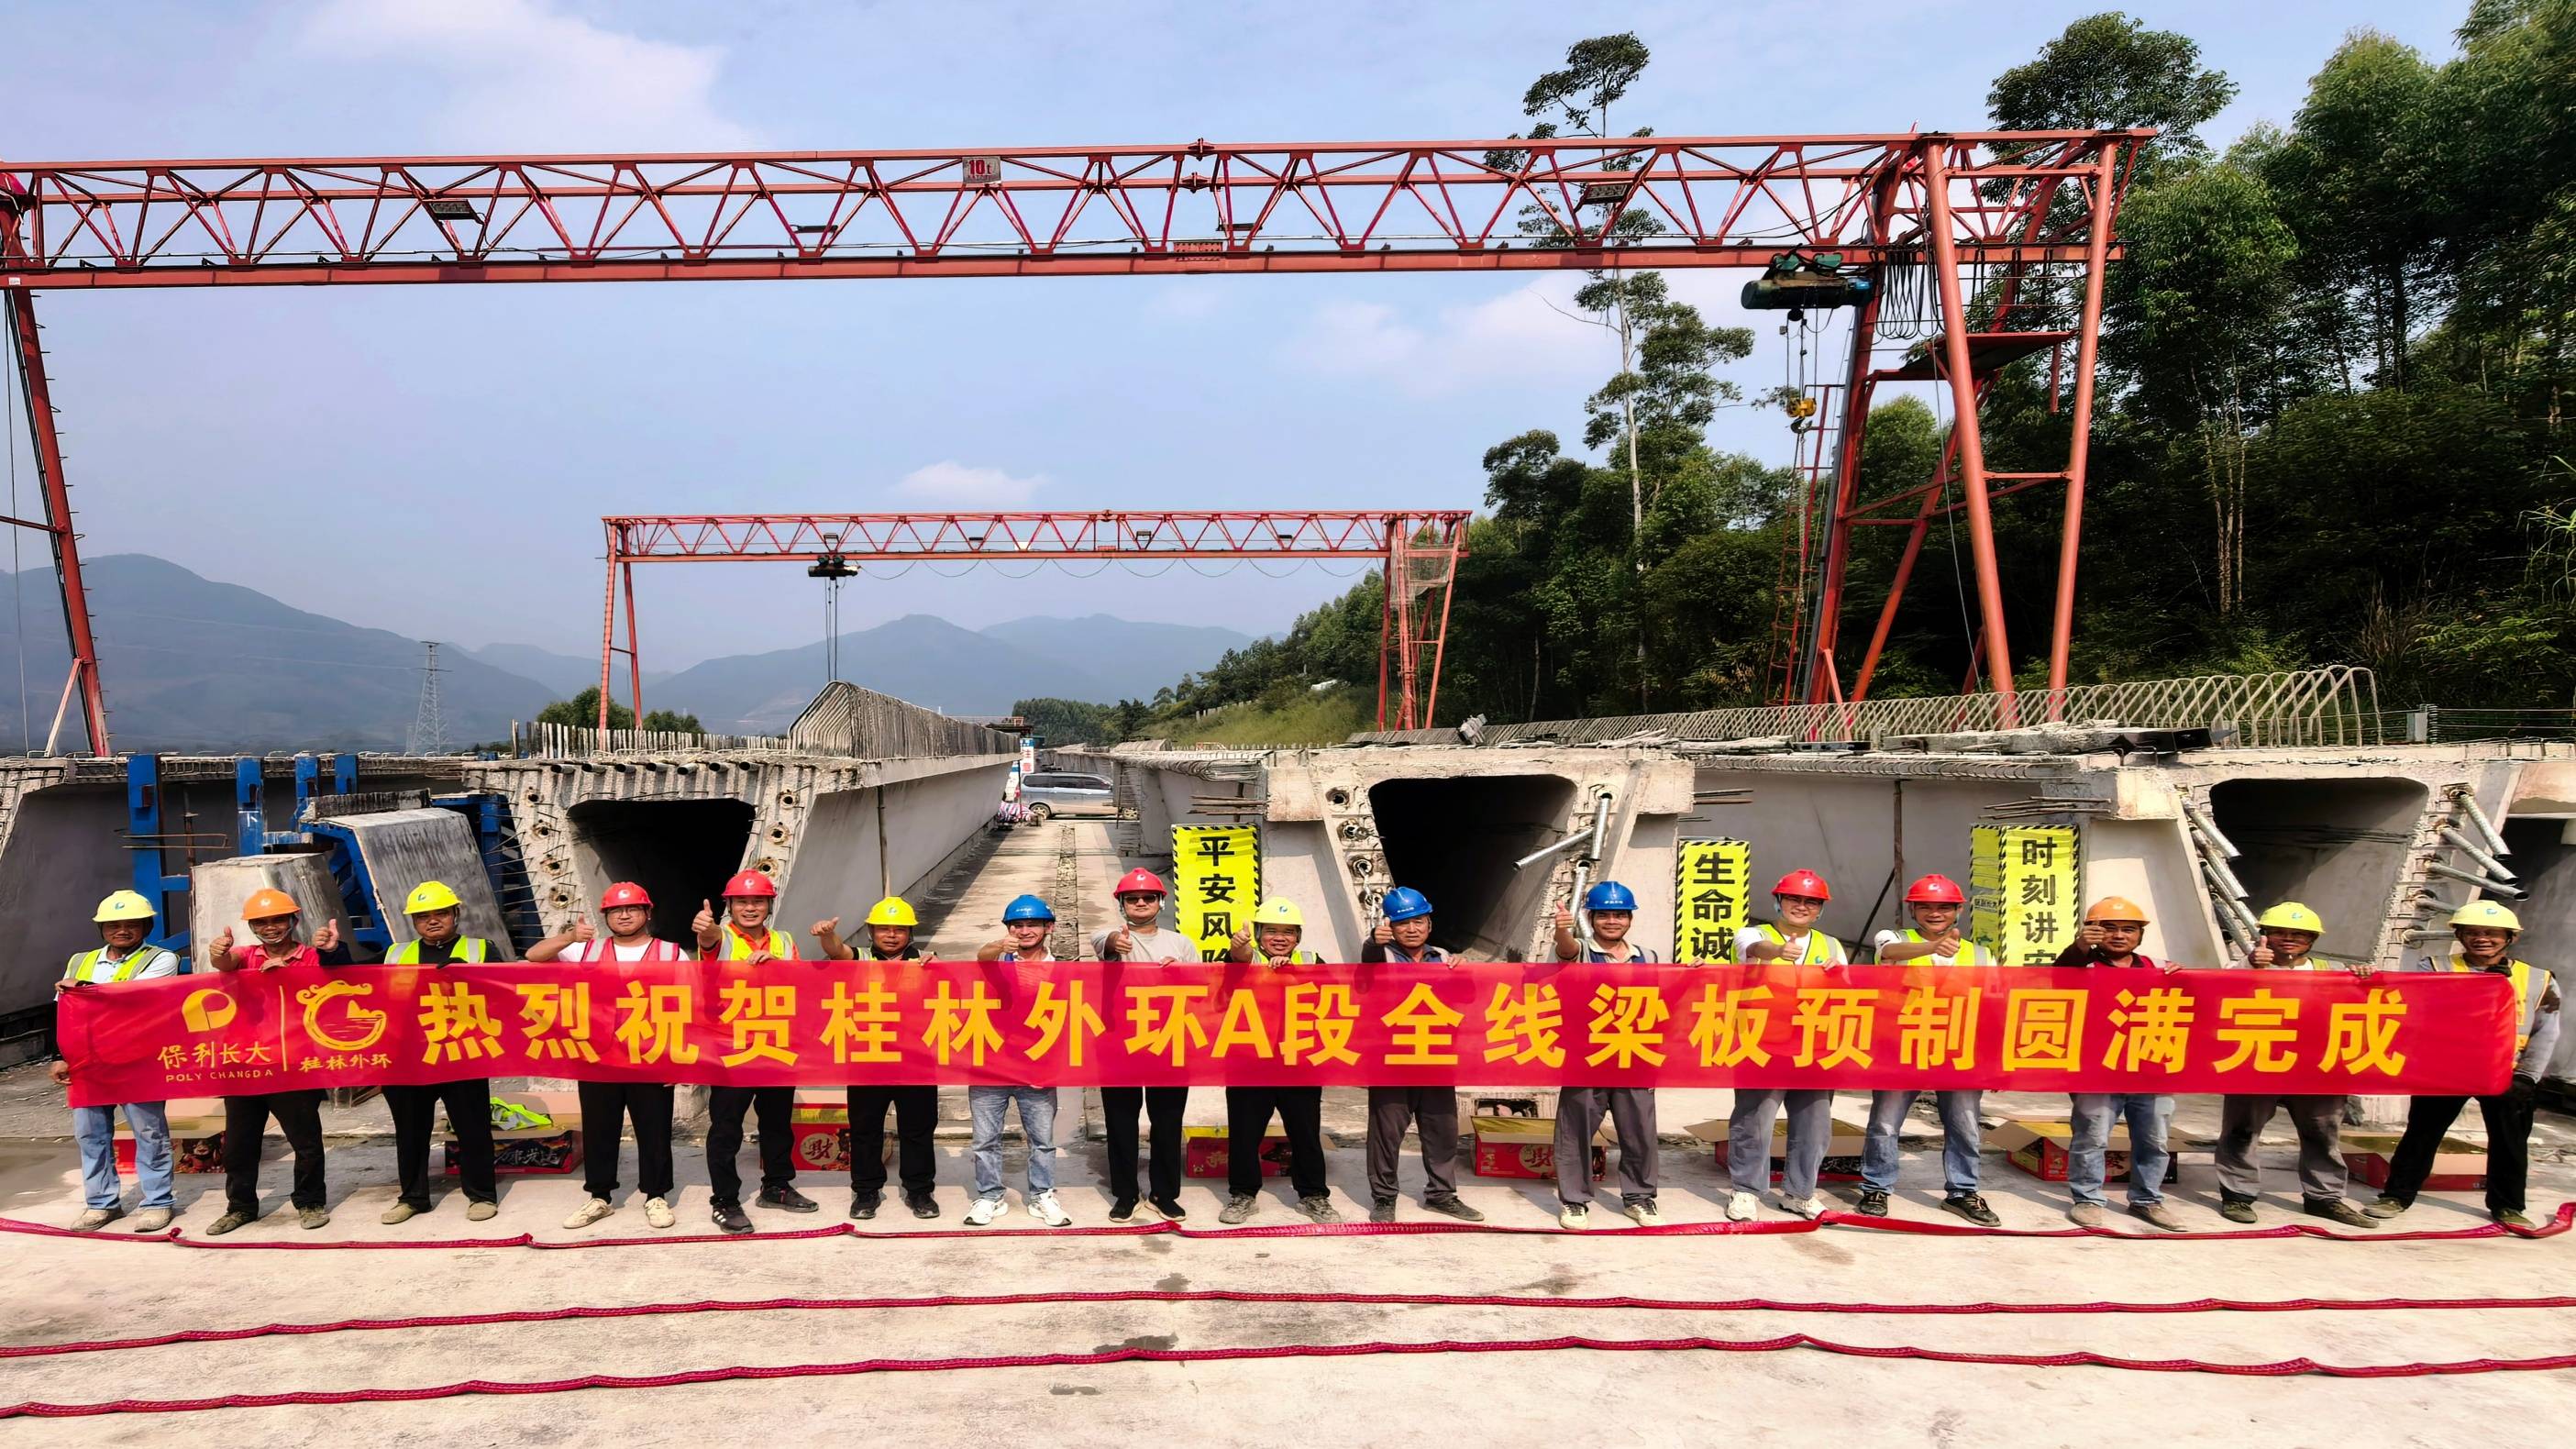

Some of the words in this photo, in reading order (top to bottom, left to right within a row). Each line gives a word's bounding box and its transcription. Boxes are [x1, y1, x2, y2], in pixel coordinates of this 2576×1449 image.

[1691, 852, 1735, 960] 生命诚
[417, 980, 2407, 1077] 热烈祝贺桂林外环A段全线梁板预制圆满完成
[157, 1041, 272, 1069] 保利长大
[299, 1054, 392, 1072] 桂林外环
[166, 1072, 202, 1082] POLY
